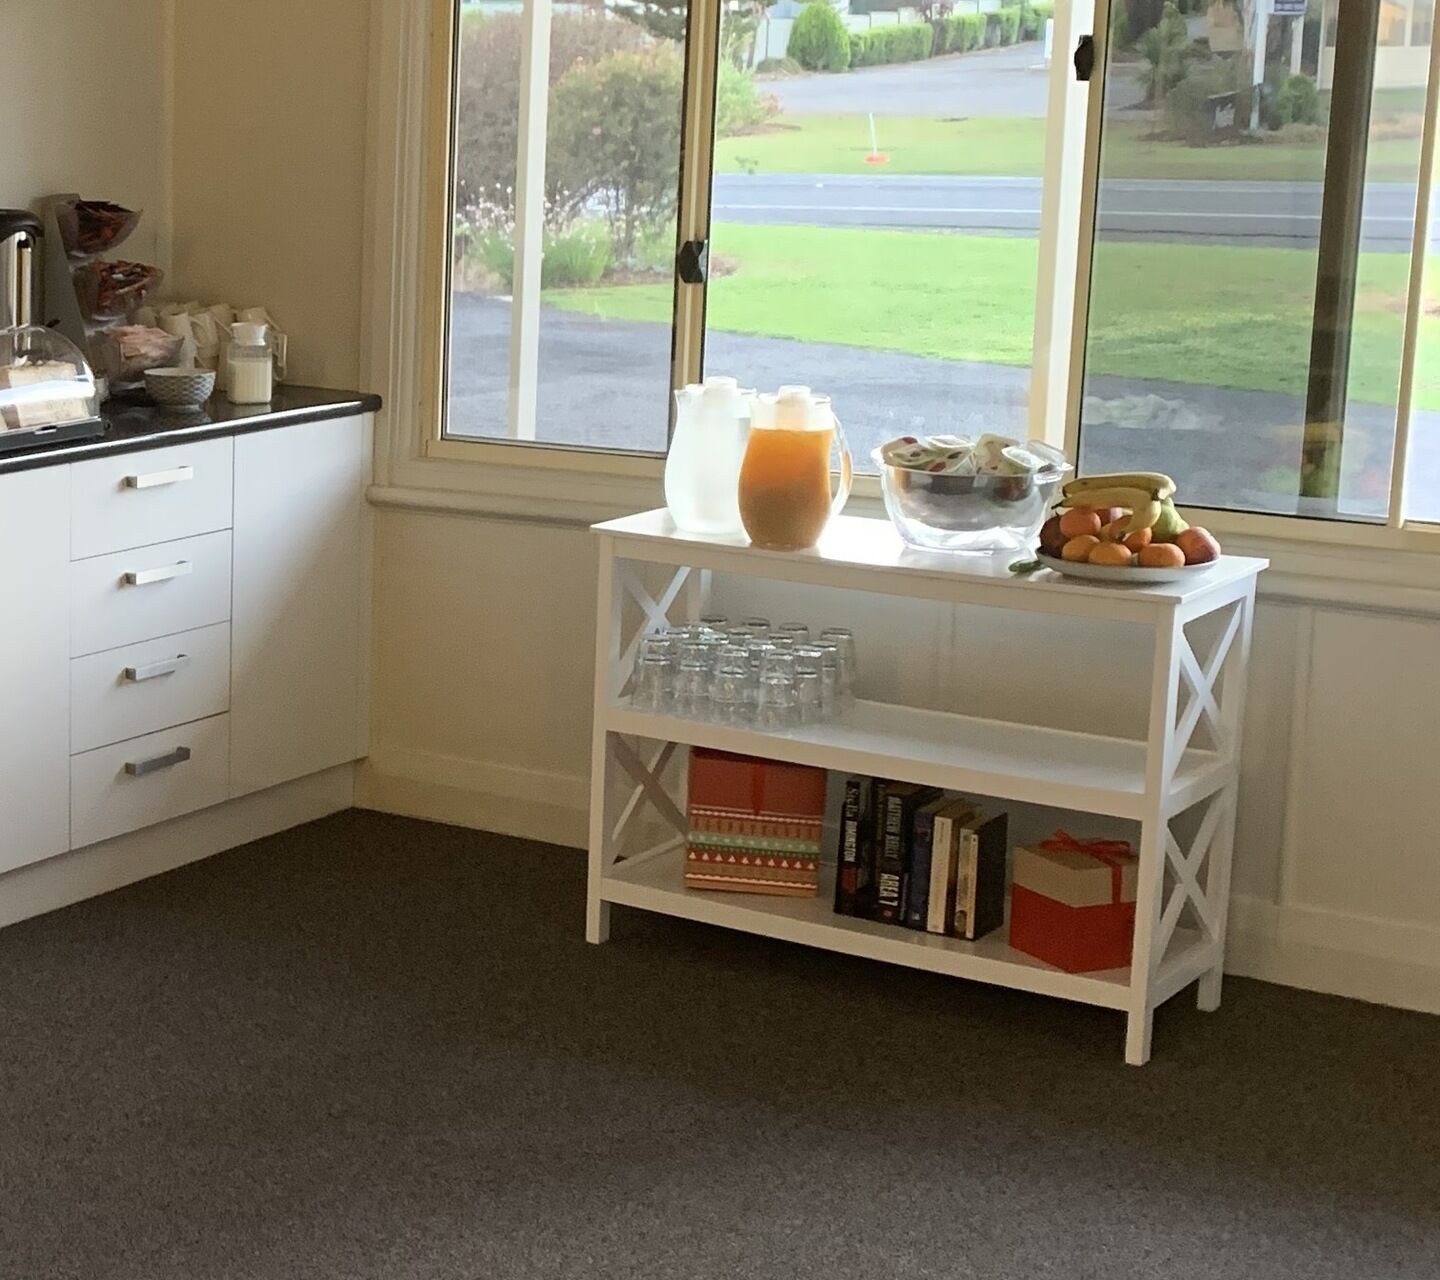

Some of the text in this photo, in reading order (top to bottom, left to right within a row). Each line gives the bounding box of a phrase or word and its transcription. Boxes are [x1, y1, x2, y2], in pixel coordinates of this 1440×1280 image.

[846, 786, 860, 818] Stella
[884, 796, 902, 859] MATTHEW REILLY
[878, 873, 900, 907] AREA 7
